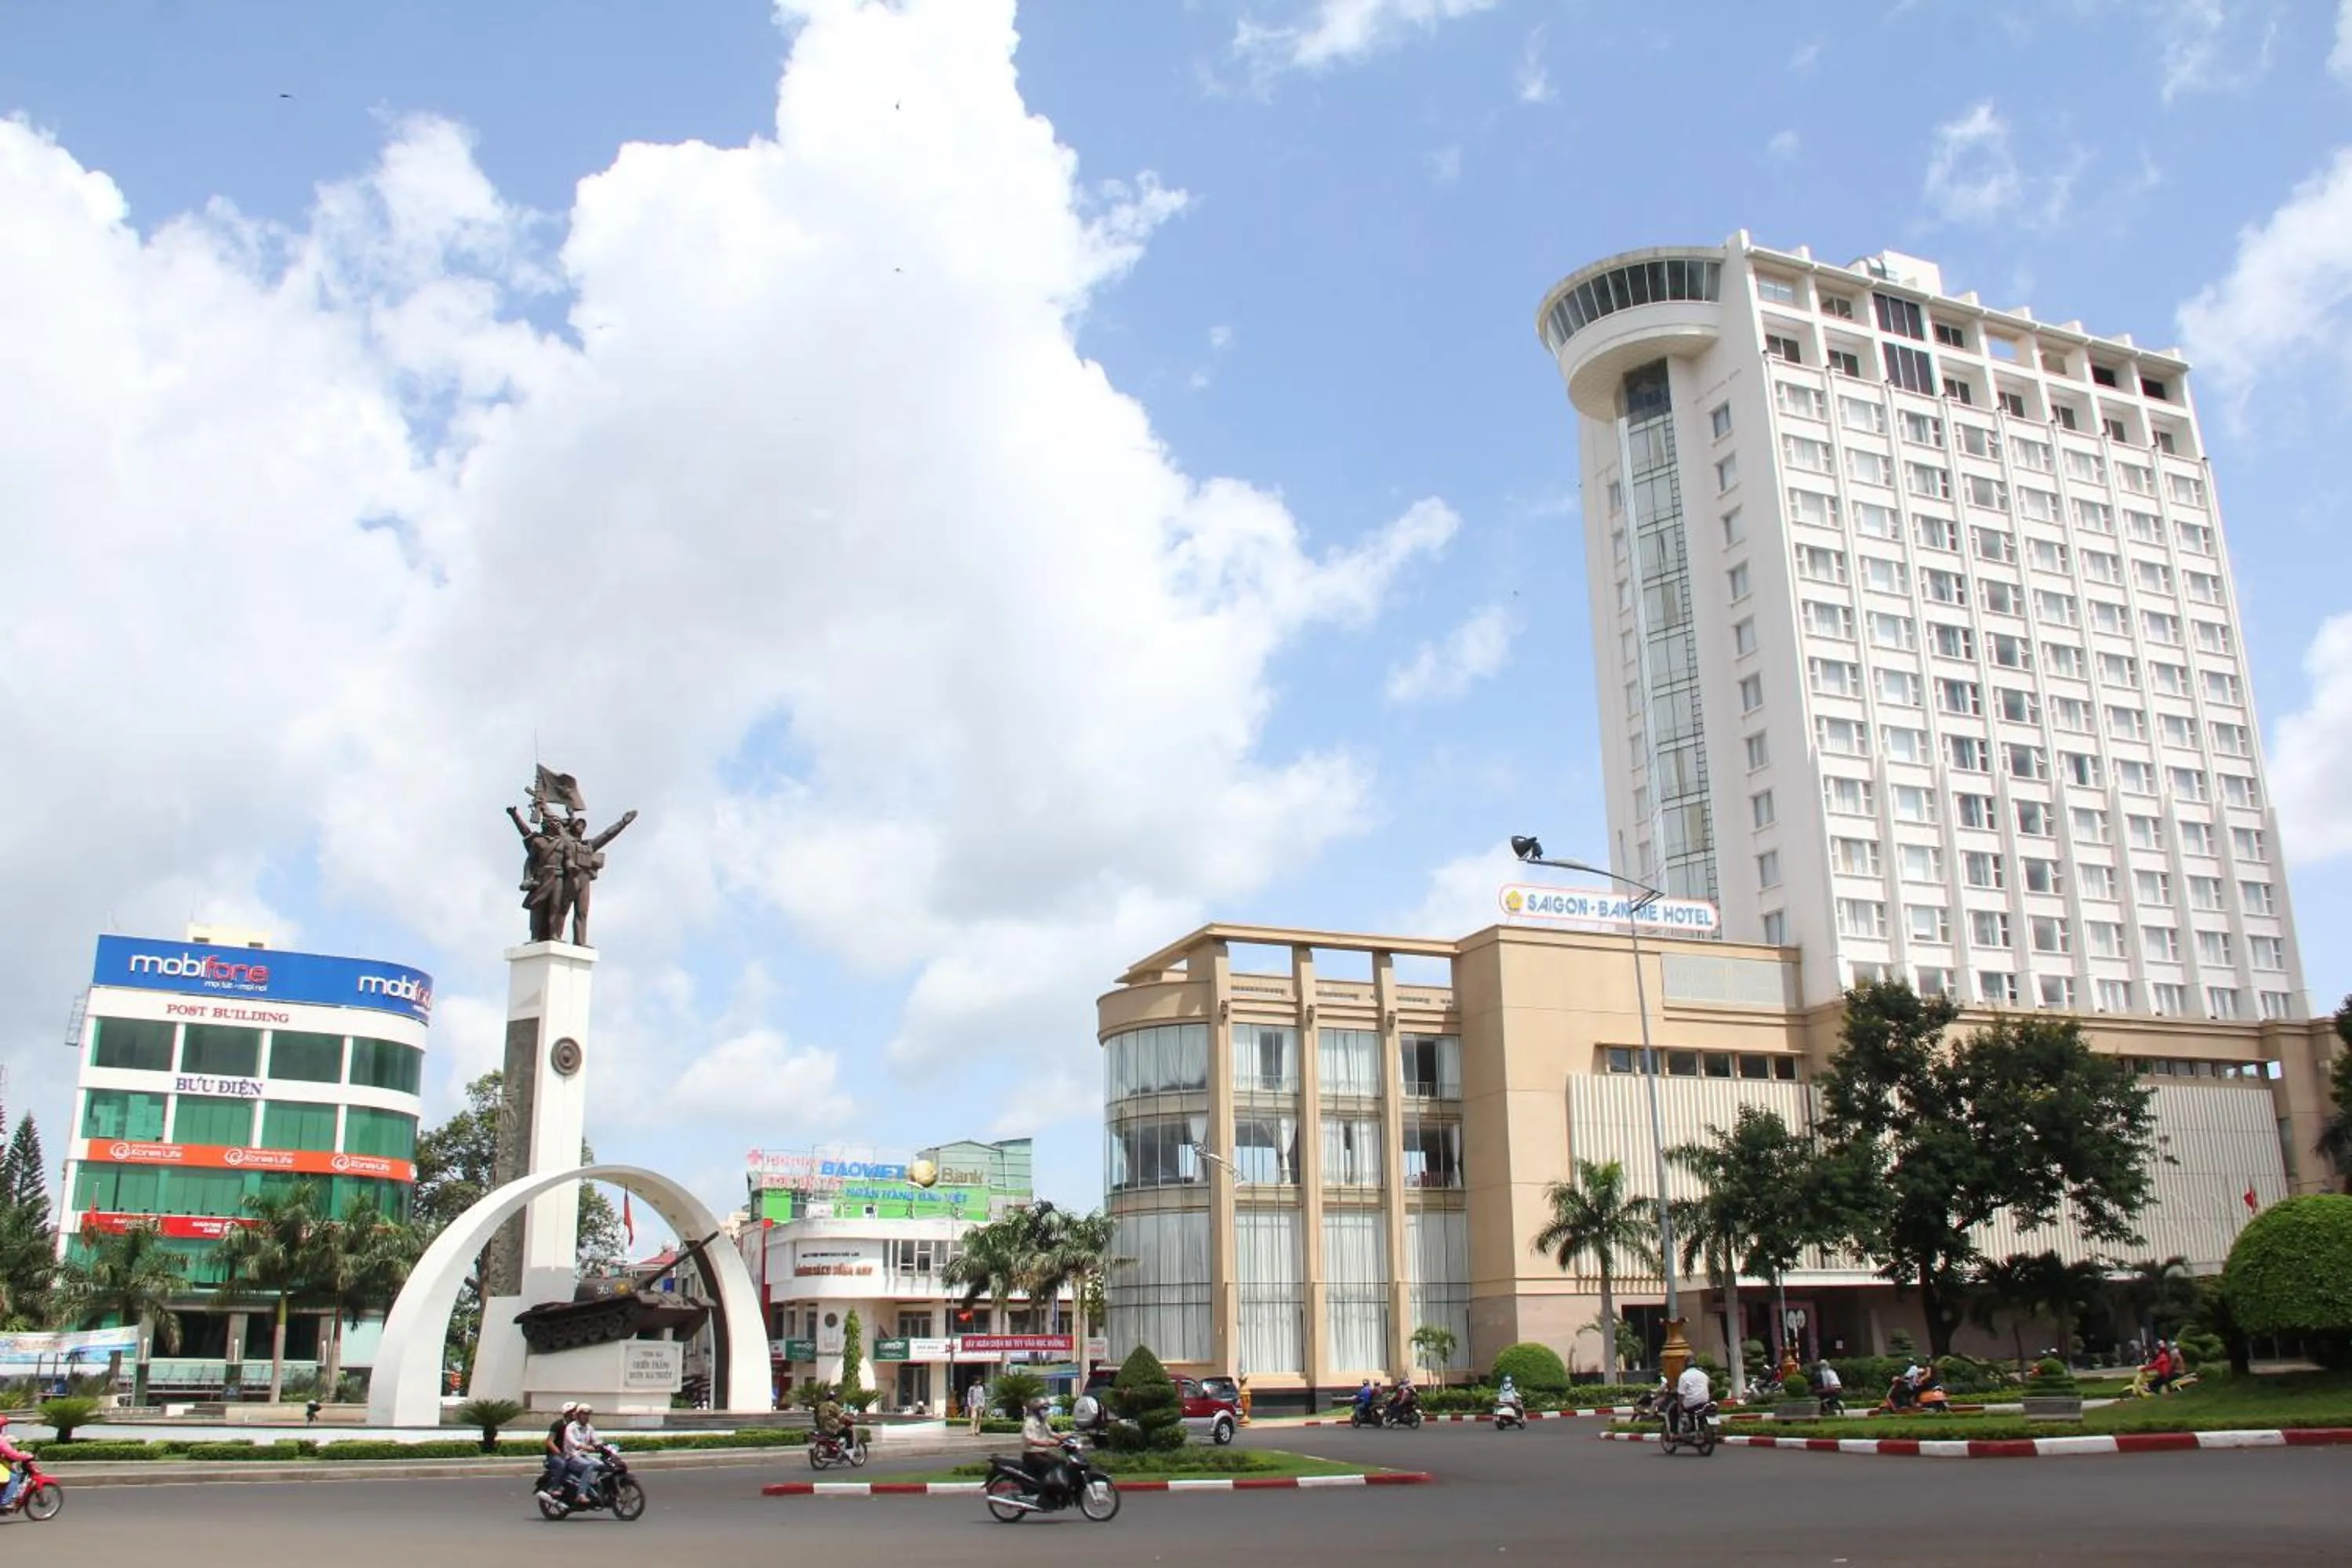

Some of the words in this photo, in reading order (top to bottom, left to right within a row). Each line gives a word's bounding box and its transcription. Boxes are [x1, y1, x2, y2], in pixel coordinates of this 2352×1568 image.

[1528, 894, 1588, 916] SAIGON
[1664, 906, 1712, 926] HOTEL
[129, 953, 269, 982] mobifone
[167, 1004, 208, 1017] POST
[212, 1007, 289, 1023] BUILDING
[175, 1076, 216, 1093] BƯU
[217, 1078, 264, 1097] ĐIỆN
[942, 1167, 984, 1183] Bank
